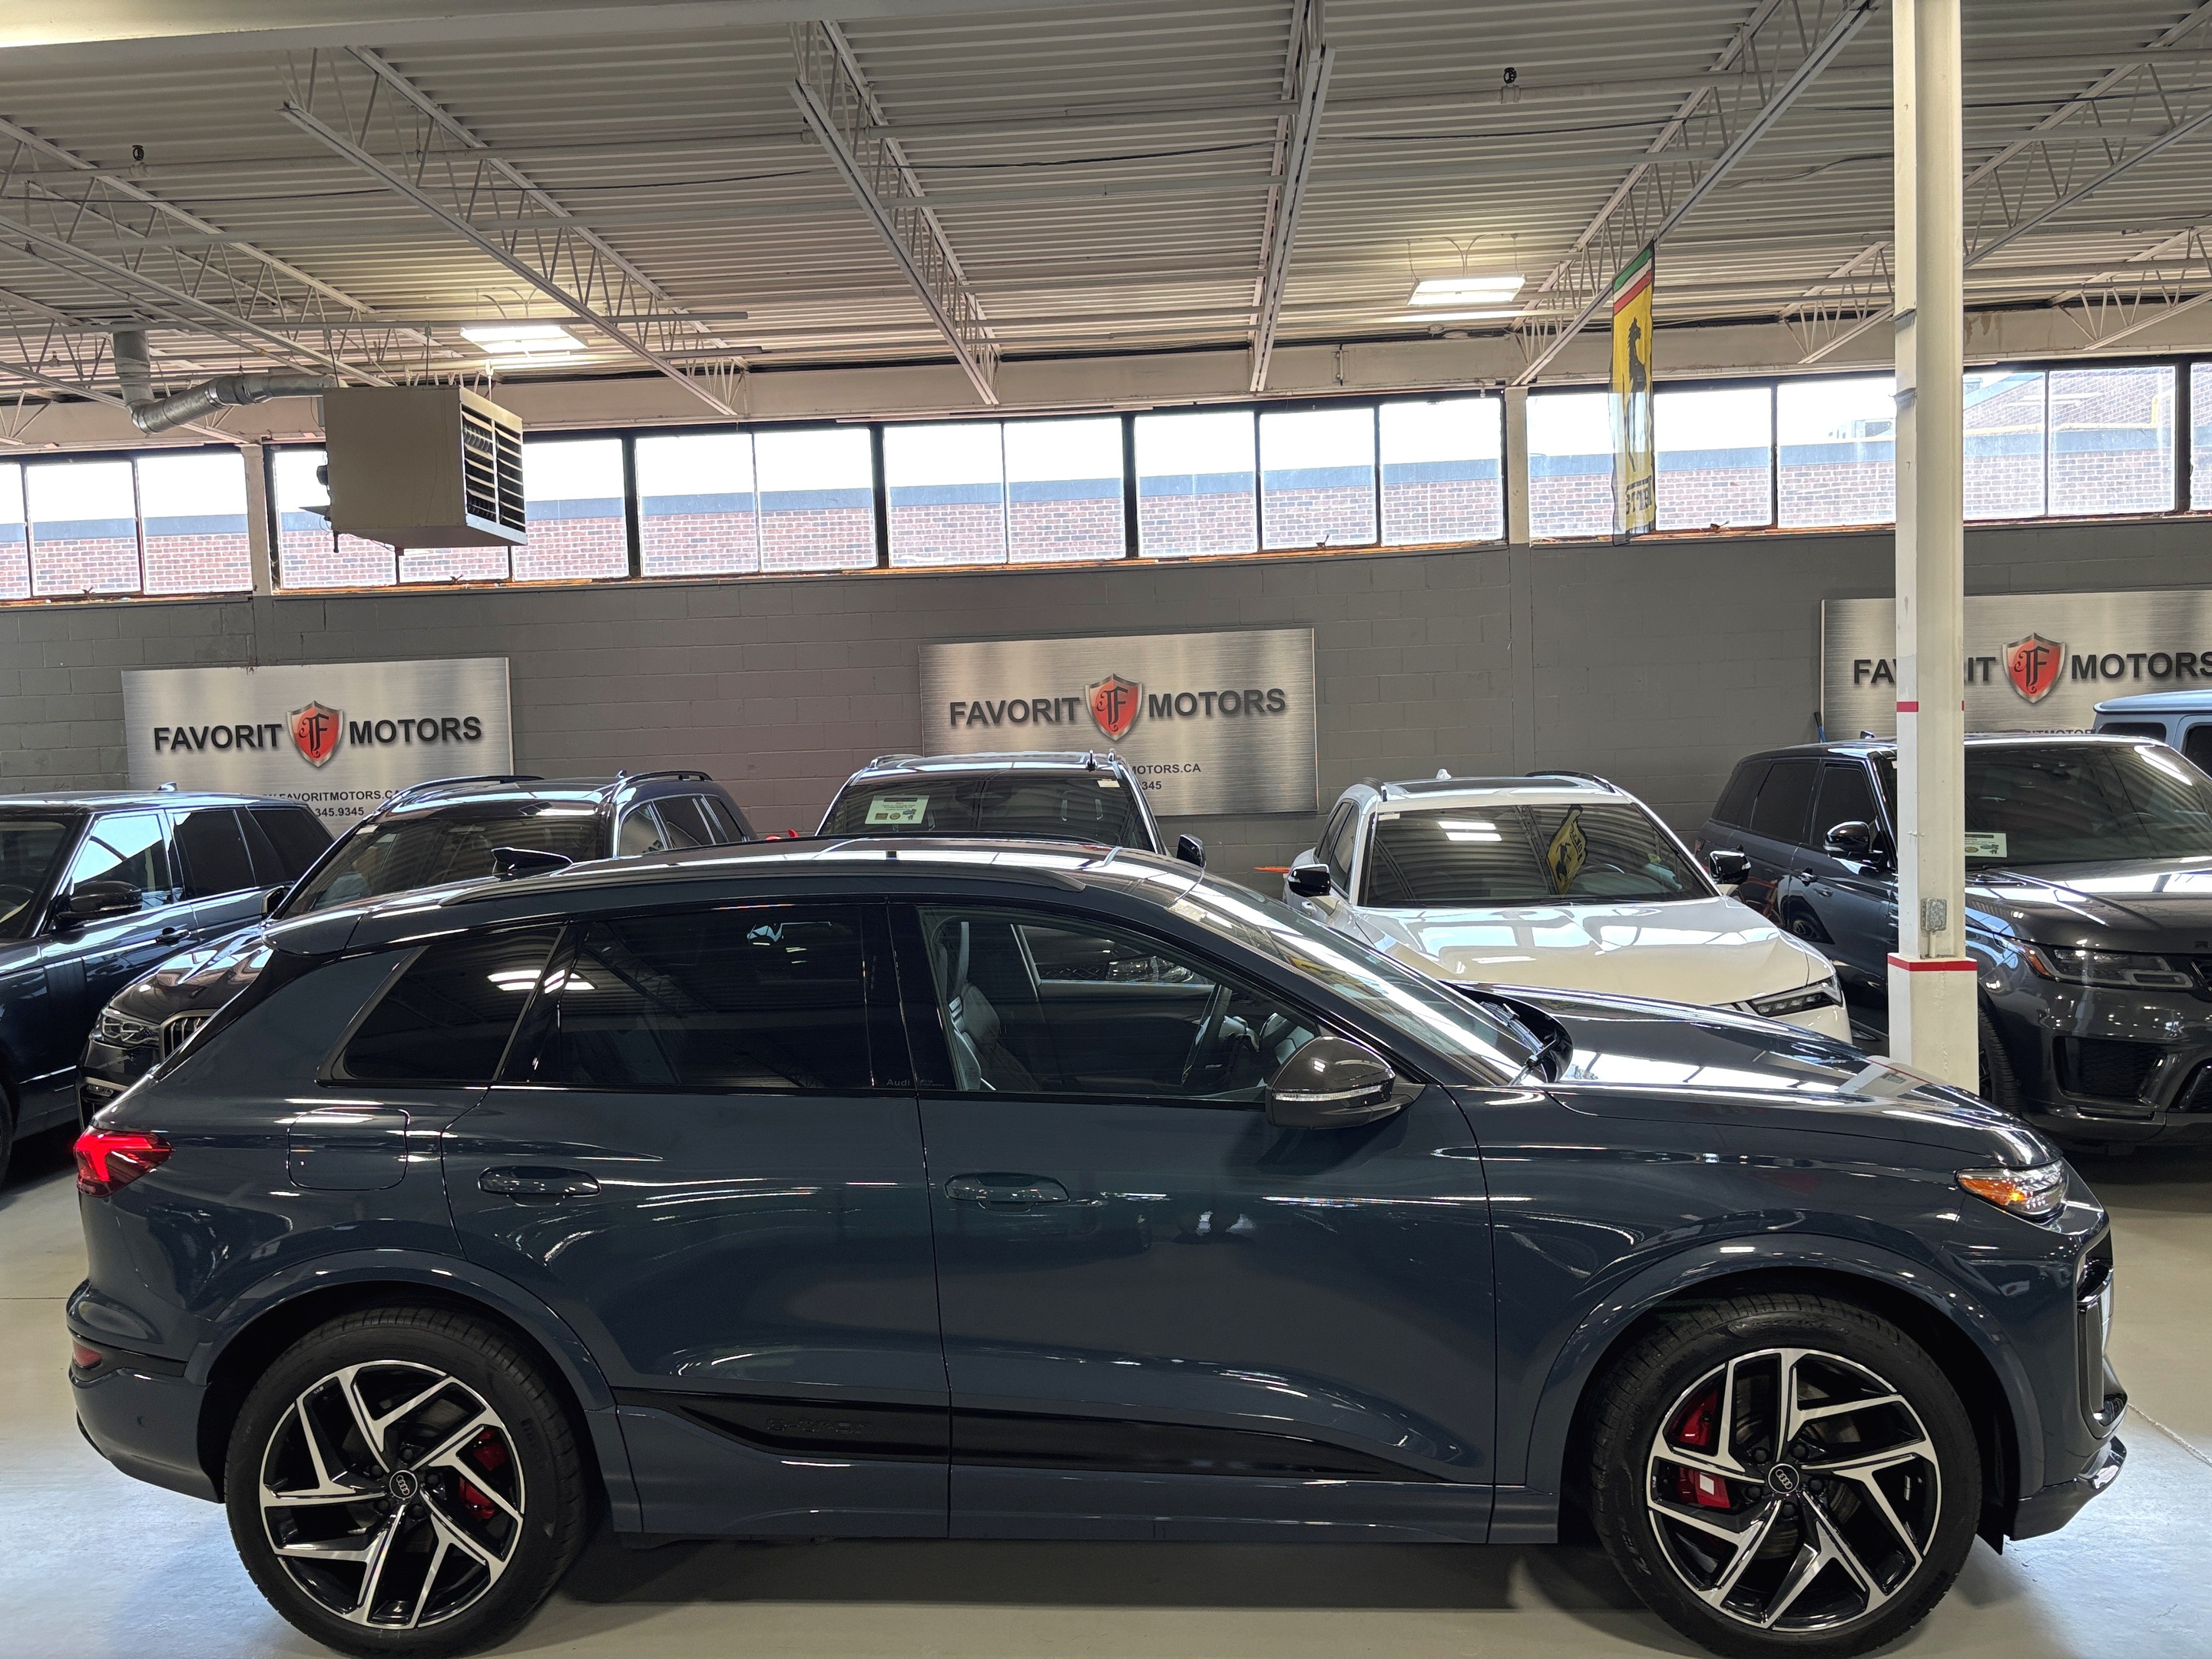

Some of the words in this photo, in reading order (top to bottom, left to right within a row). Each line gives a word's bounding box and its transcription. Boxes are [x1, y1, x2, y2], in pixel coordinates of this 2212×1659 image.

[1853, 657, 1996, 684] FAIT
[949, 697, 1080, 725] FAVORIT
[1148, 688, 1286, 718] MOTORS
[154, 724, 282, 750] FAVORIT
[349, 717, 482, 744] MOTORS
[315, 806, 364, 816] 345.9345
